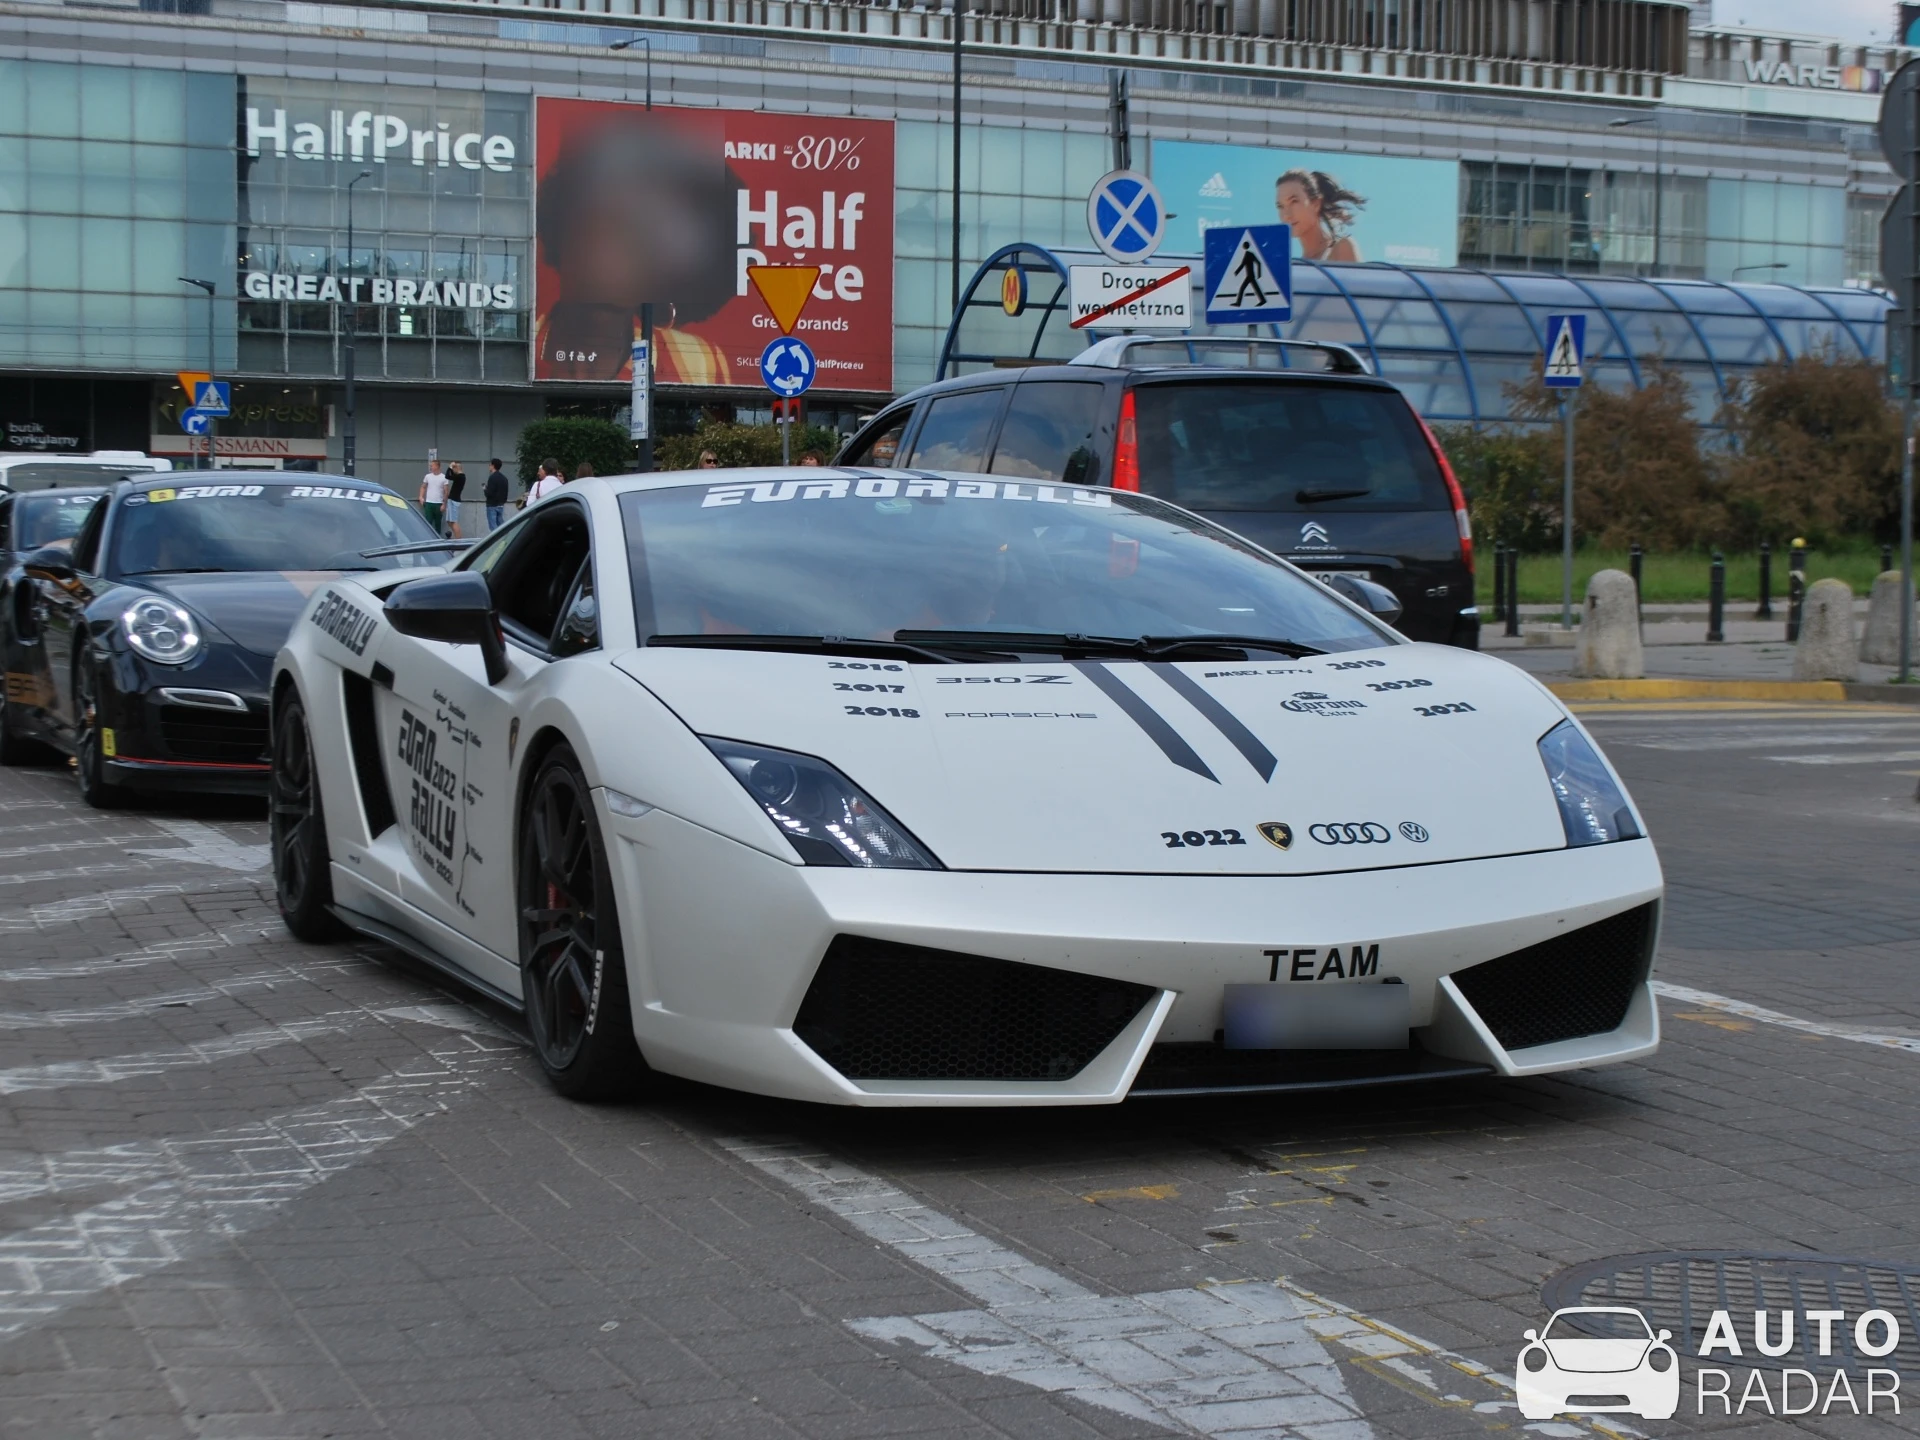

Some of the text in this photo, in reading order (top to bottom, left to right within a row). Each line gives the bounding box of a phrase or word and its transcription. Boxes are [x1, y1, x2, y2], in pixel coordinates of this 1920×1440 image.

[1743, 60, 1840, 89] WARS
[246, 108, 516, 172] HalfPrice
[724, 141, 776, 161] ARKI
[737, 189, 866, 251] Half
[737, 248, 864, 302] Pce
[1101, 271, 1159, 295] Droga
[245, 272, 515, 310] GREAT BRANDS
[1077, 301, 1185, 319] wewnętrzna
[797, 317, 849, 332] brands
[230, 402, 319, 426] xpress
[8, 422, 44, 433] butik
[176, 485, 264, 500] EURO
[827, 661, 904, 672] 2016
[1326, 659, 1386, 671] 2019
[832, 682, 905, 694] 2017
[935, 674, 1073, 685] 350Z
[1365, 678, 1433, 692] 2020
[844, 705, 921, 719] 2018
[1280, 699, 1368, 713] Corona
[1412, 702, 1477, 717] 2021
[432, 761, 457, 801] 2022
[1161, 829, 1247, 849] 2022
[1263, 944, 1380, 982] TEAM
